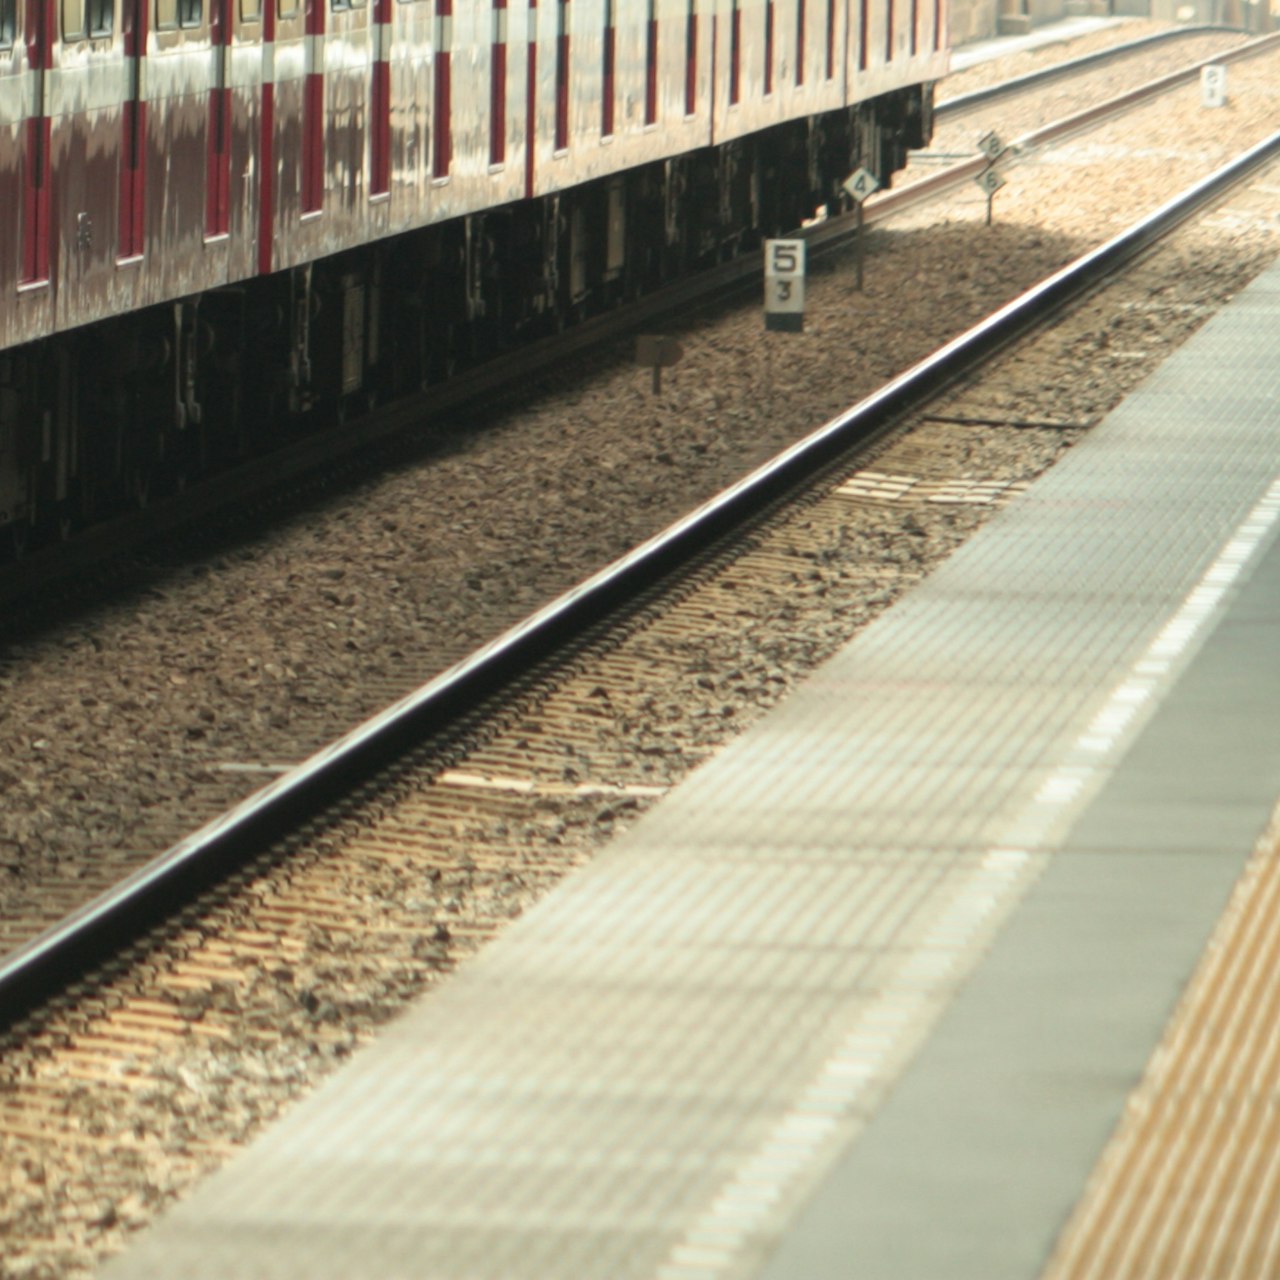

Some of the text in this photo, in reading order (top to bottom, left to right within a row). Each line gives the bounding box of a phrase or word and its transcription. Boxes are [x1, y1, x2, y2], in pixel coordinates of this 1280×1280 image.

[854, 174, 867, 193] 4
[773, 244, 797, 272] 5
[776, 281, 791, 301] 3
